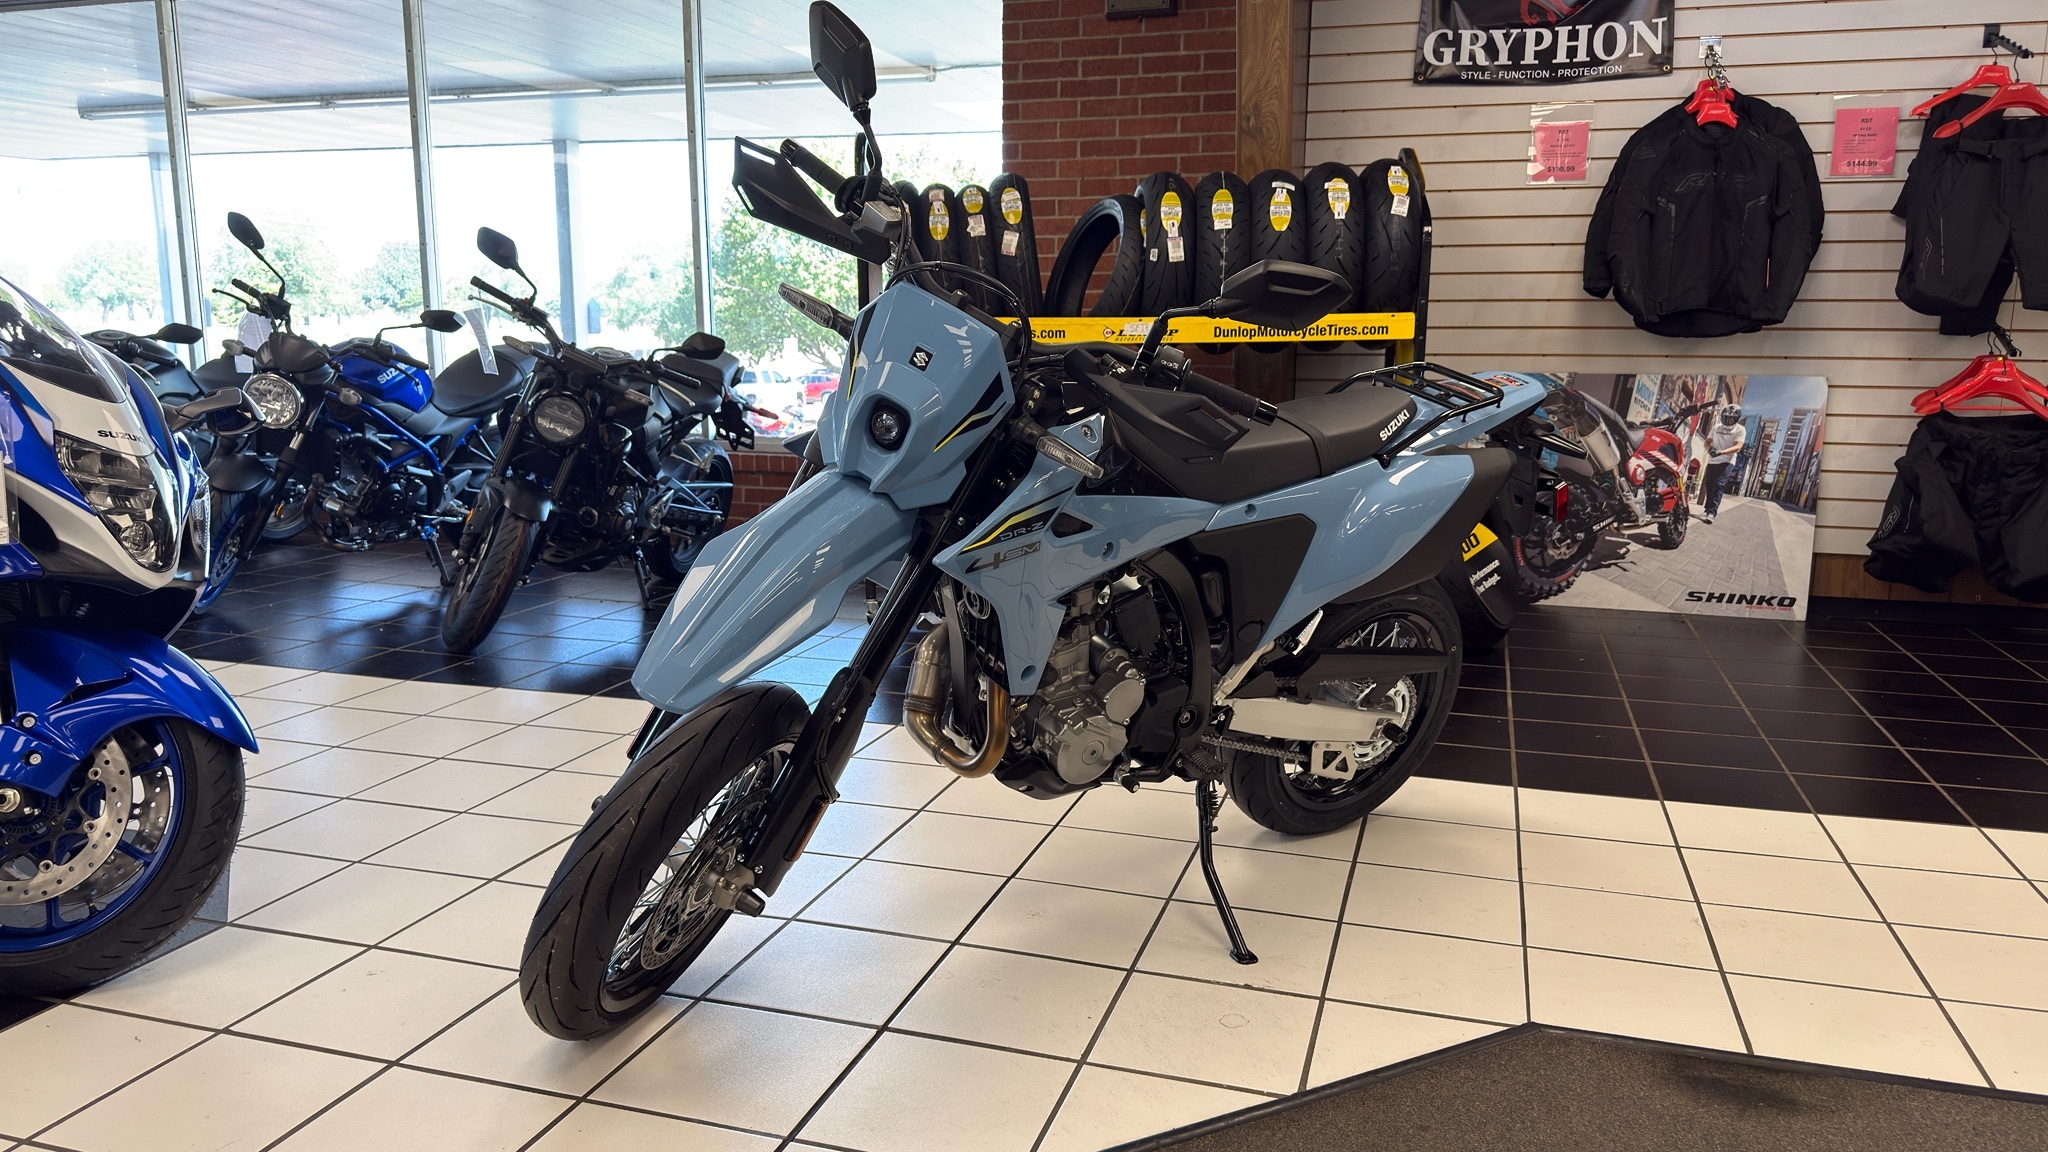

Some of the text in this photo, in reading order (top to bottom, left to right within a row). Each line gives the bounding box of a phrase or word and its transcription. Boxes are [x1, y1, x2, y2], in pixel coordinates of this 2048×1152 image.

[1423, 17, 1667, 66] GRYPHON
[1460, 72, 1491, 80] STYLE
[1498, 70, 1550, 79] FUNCTION
[1558, 64, 1623, 77] PROTECTION
[1213, 324, 1389, 340] DunlopMotorcycleTires.com
[1379, 409, 1410, 441] SUZUKI
[999, 521, 1044, 541] DR-Z
[1684, 591, 1797, 608] SHINKO
